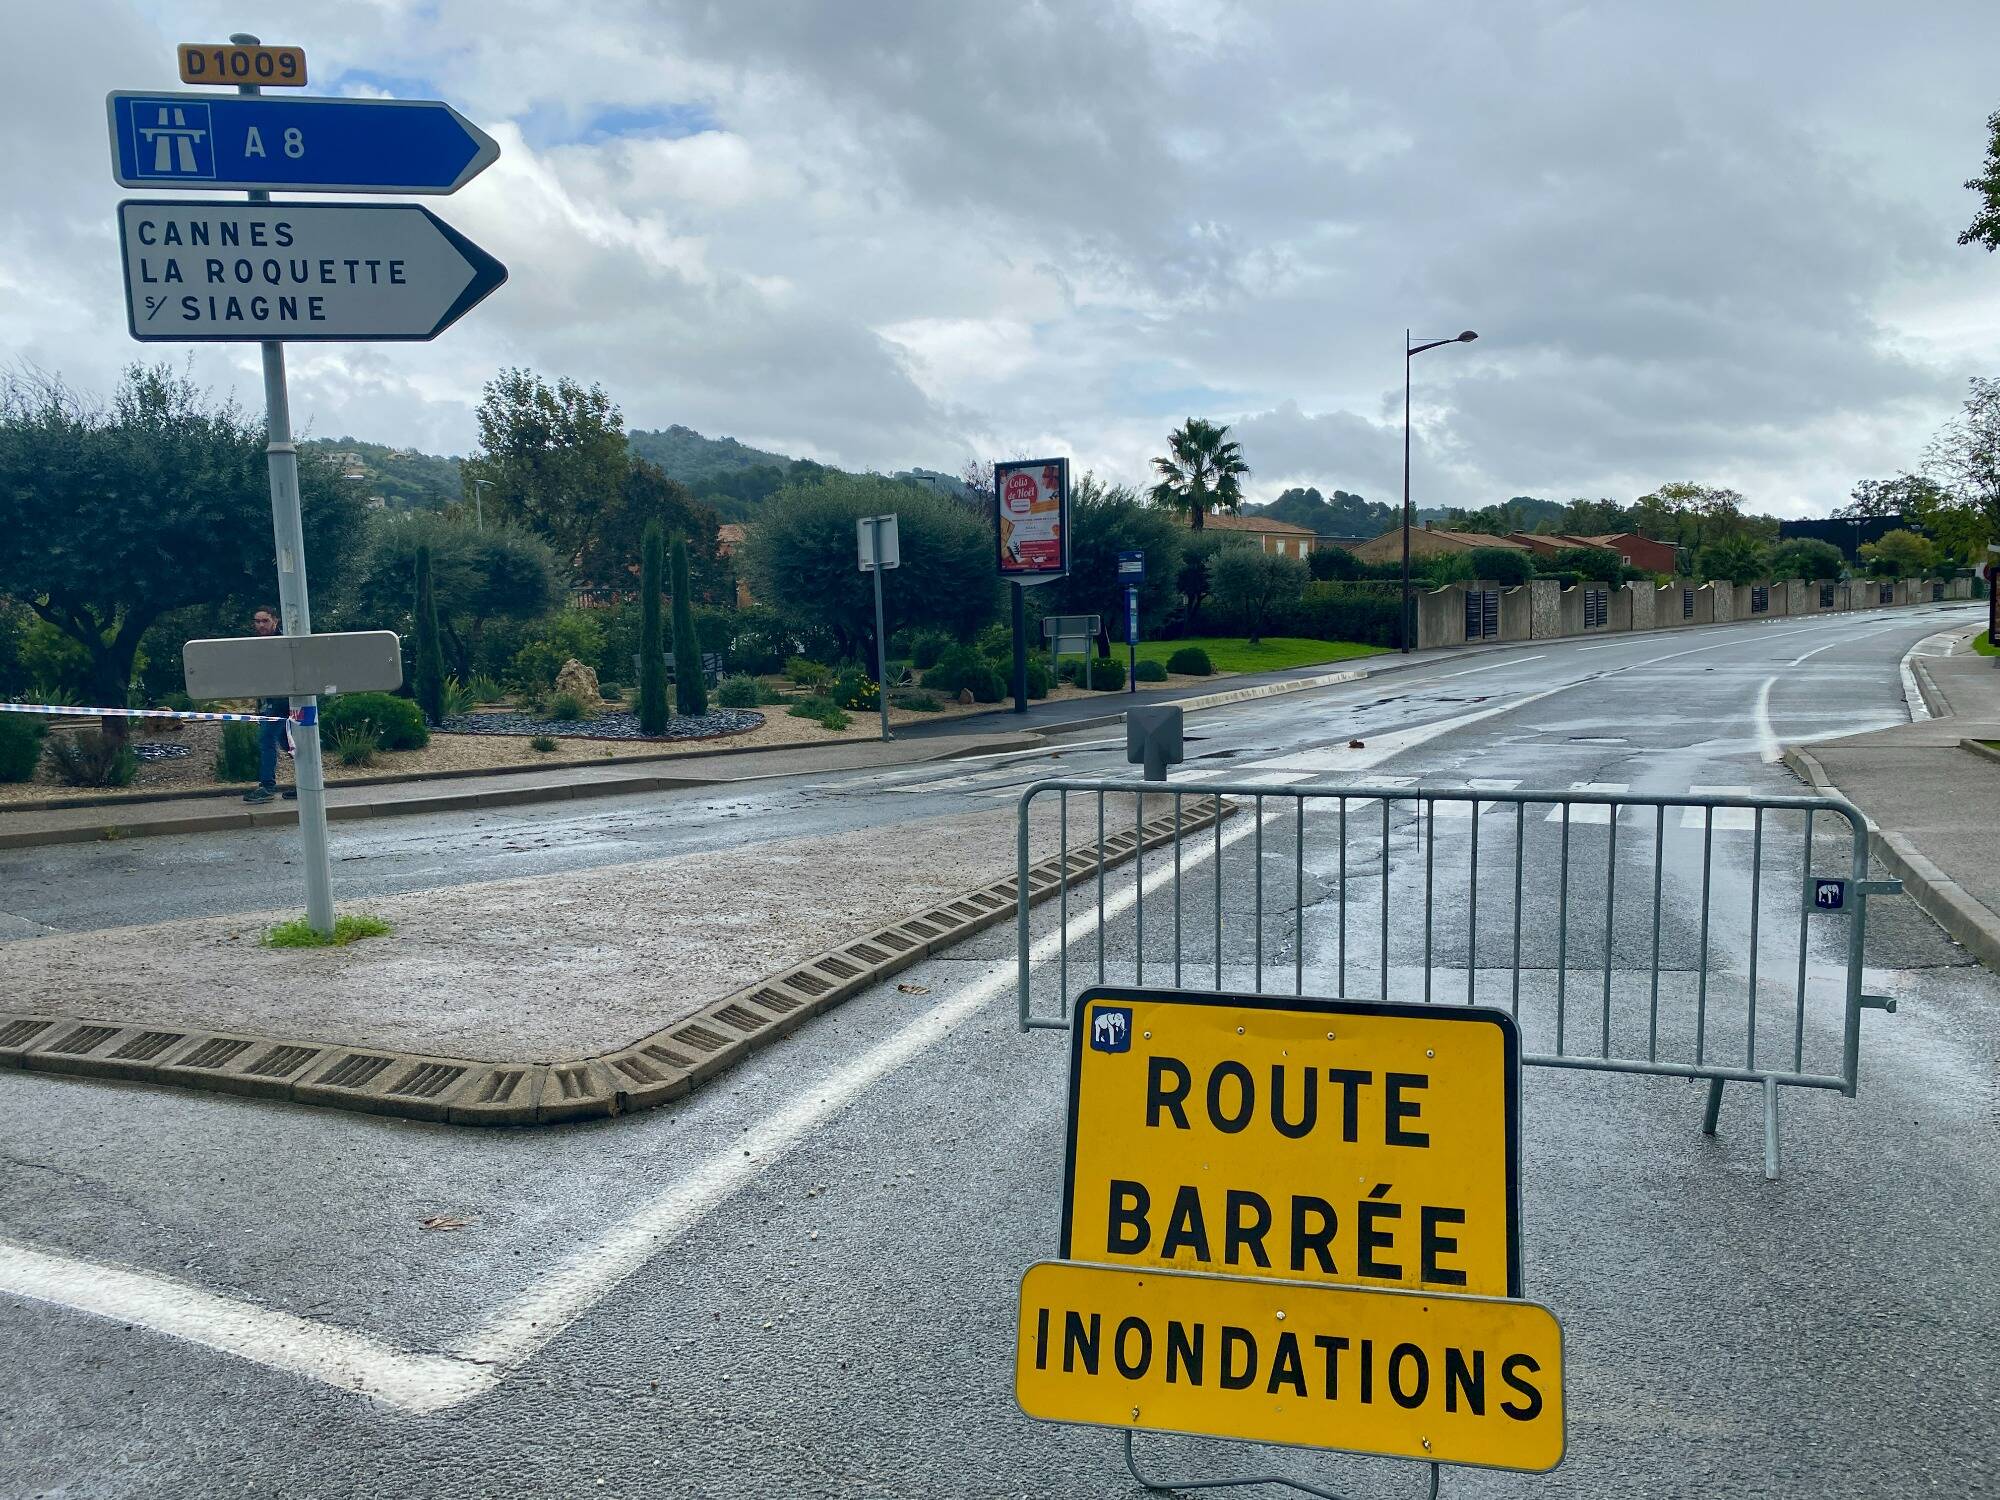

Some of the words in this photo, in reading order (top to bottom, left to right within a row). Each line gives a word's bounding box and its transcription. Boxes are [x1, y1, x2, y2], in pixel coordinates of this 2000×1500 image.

[244, 126, 266, 158] A
[285, 128, 305, 158] 8
[138, 221, 294, 247] CANNES
[140, 258, 183, 284] LA
[206, 259, 406, 286] ROQUETTE
[182, 296, 326, 321] SIAGNE
[1146, 1056, 1430, 1148] ROUTE
[1107, 1180, 1467, 1286] BARRÉE
[1036, 1308, 1543, 1421] INONDATIONS
